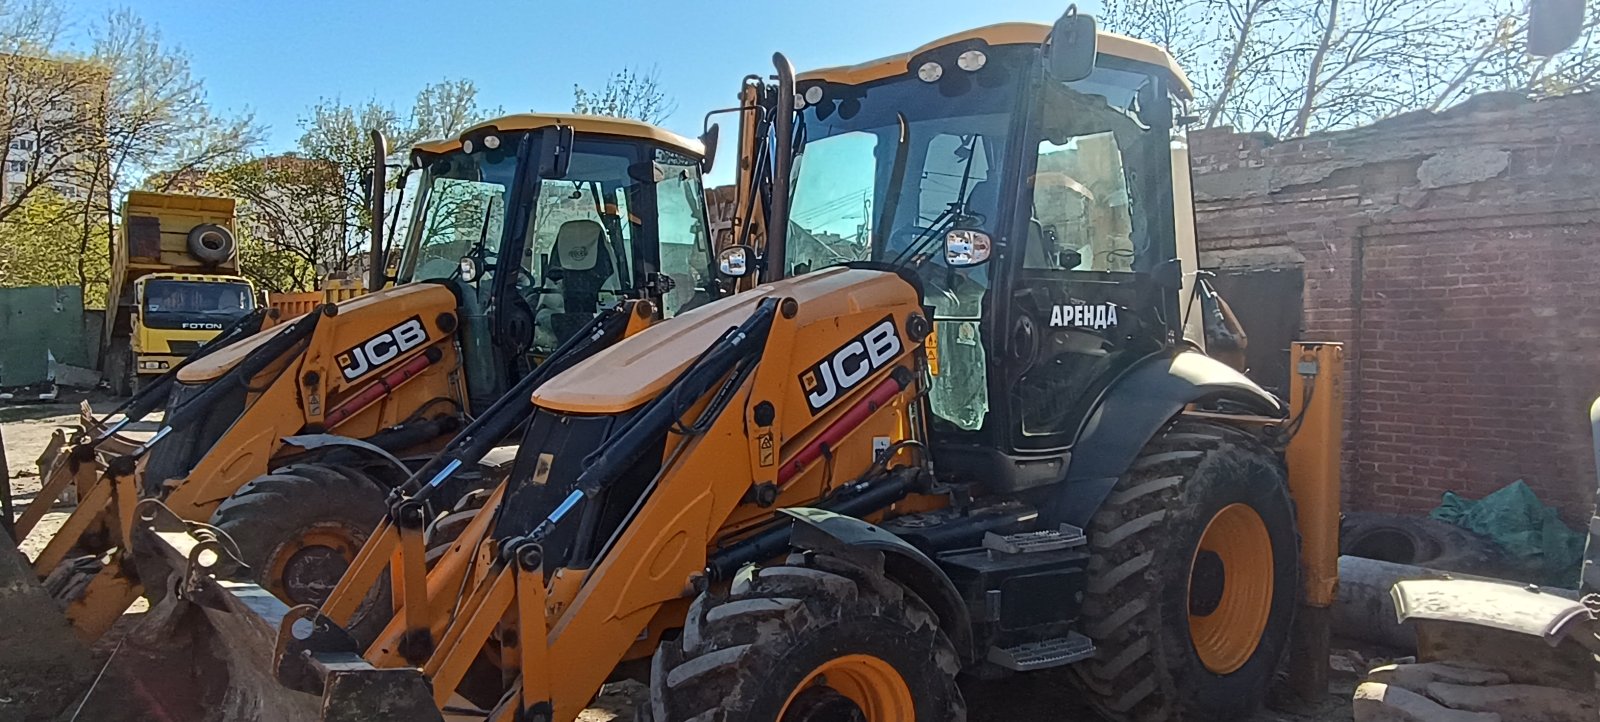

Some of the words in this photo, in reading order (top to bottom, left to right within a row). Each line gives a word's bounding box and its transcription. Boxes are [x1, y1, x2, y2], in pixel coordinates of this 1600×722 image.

[1049, 304, 1118, 329] АРЕНДА
[343, 319, 426, 379] JCB
[808, 321, 901, 409] JCB
